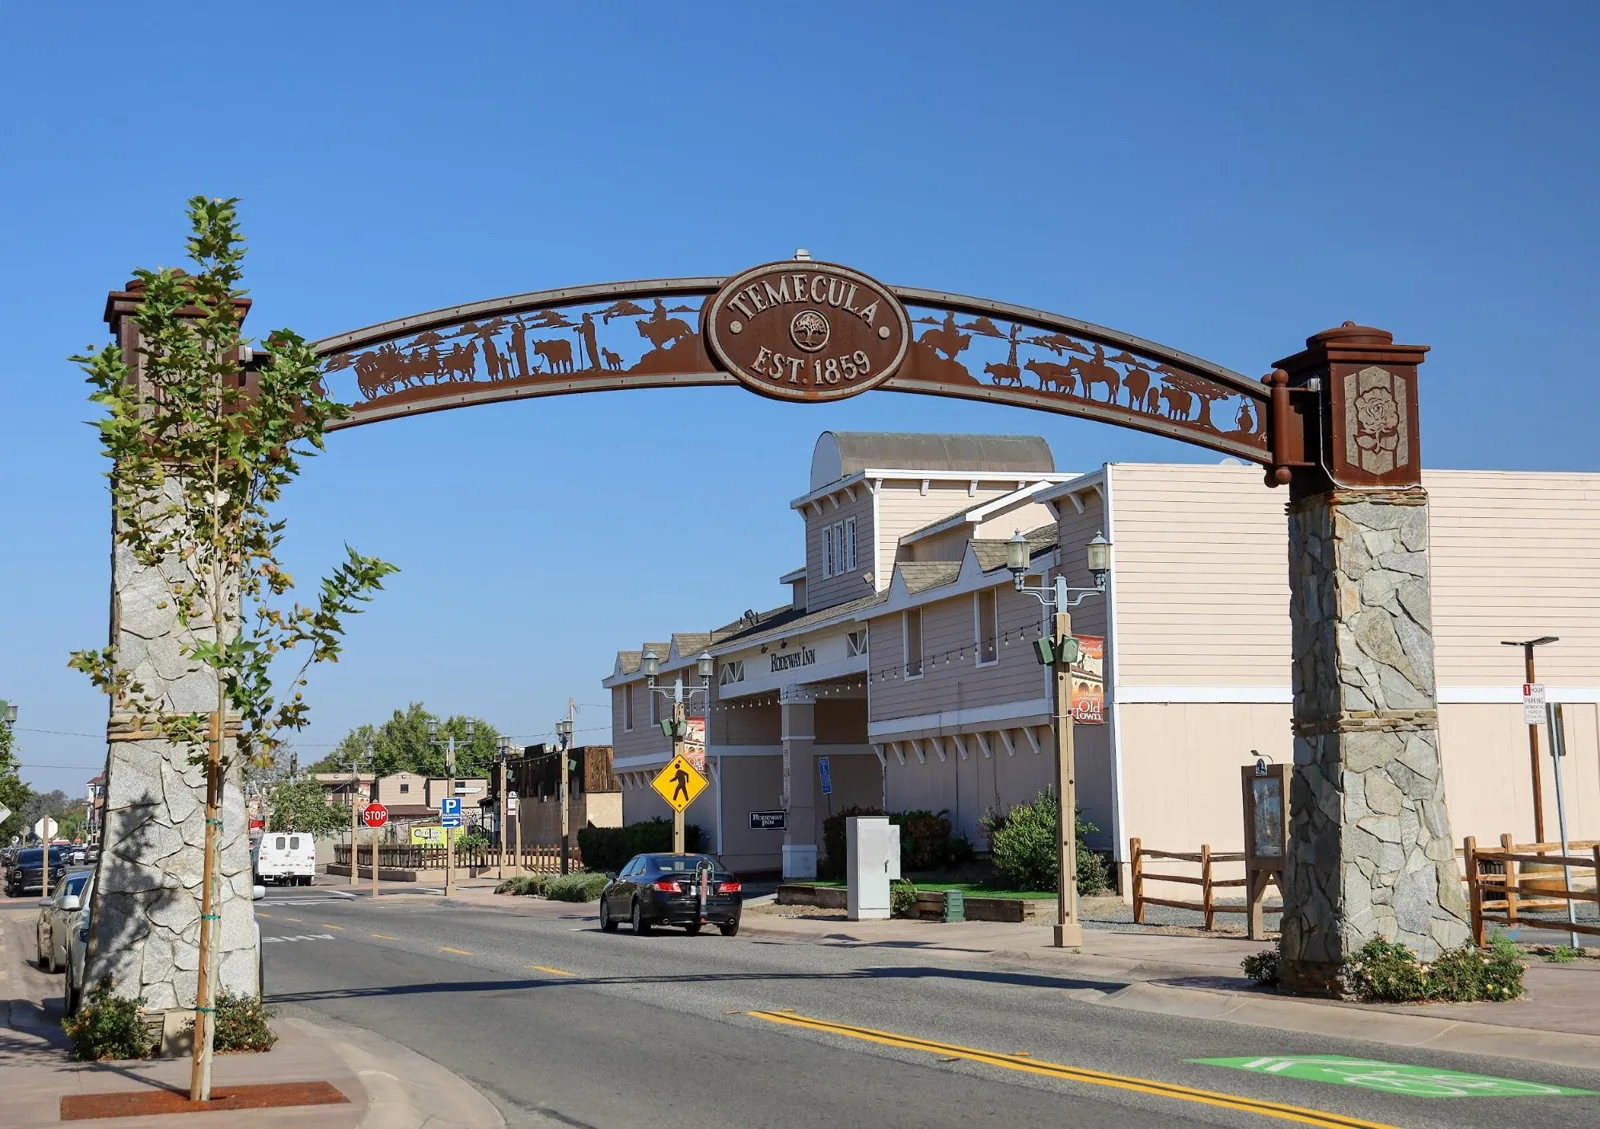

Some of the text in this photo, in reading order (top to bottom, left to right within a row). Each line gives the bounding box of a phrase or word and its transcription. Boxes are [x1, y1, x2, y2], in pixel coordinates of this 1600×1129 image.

[727, 274, 880, 328] TEMECULA
[751, 346, 871, 385] EST. 1859
[802, 646, 815, 666] INN
[1078, 700, 1100, 713] Old
[1072, 708, 1102, 720] Town
[446, 800, 457, 813] P
[365, 811, 386, 820] STOP
